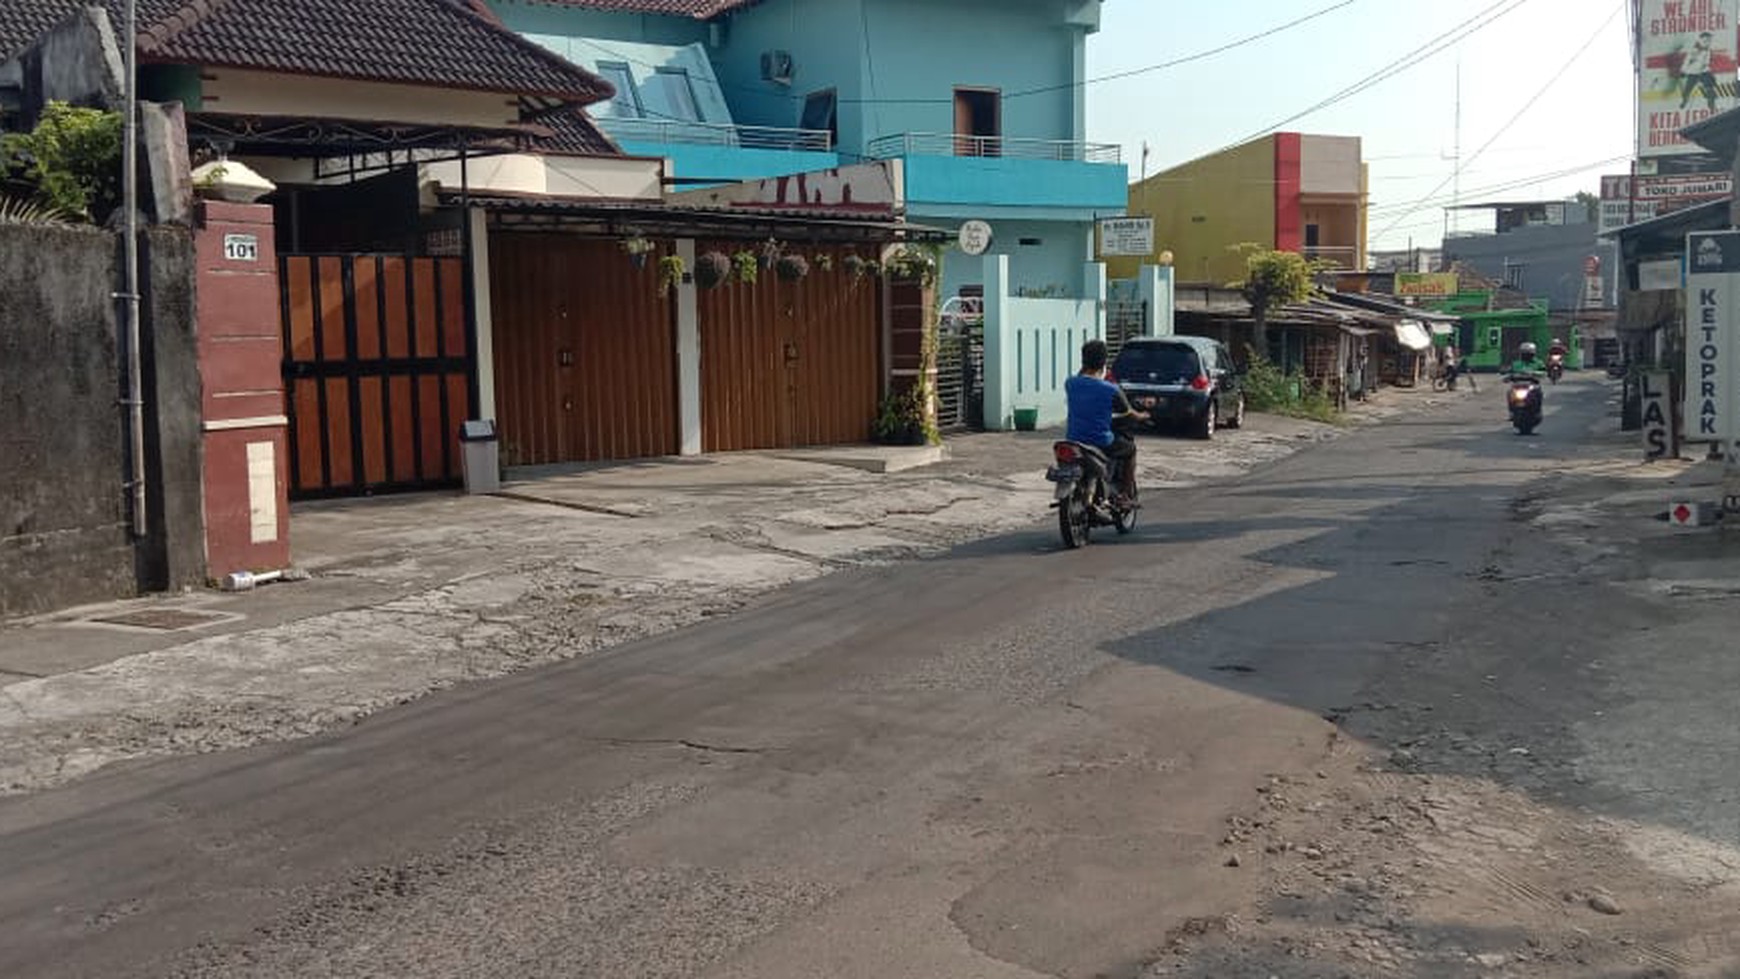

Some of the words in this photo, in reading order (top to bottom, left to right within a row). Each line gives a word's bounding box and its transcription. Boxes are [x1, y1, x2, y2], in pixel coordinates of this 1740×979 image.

[1664, 2, 1684, 17] WE
[1650, 12, 1727, 35] STRONGER
[1648, 111, 1681, 129] KITA
[1644, 185, 1678, 196] TOKO
[226, 243, 256, 258] 101
[1699, 287, 1718, 435] KETOPRAK
[1643, 376, 1667, 459] LAS
